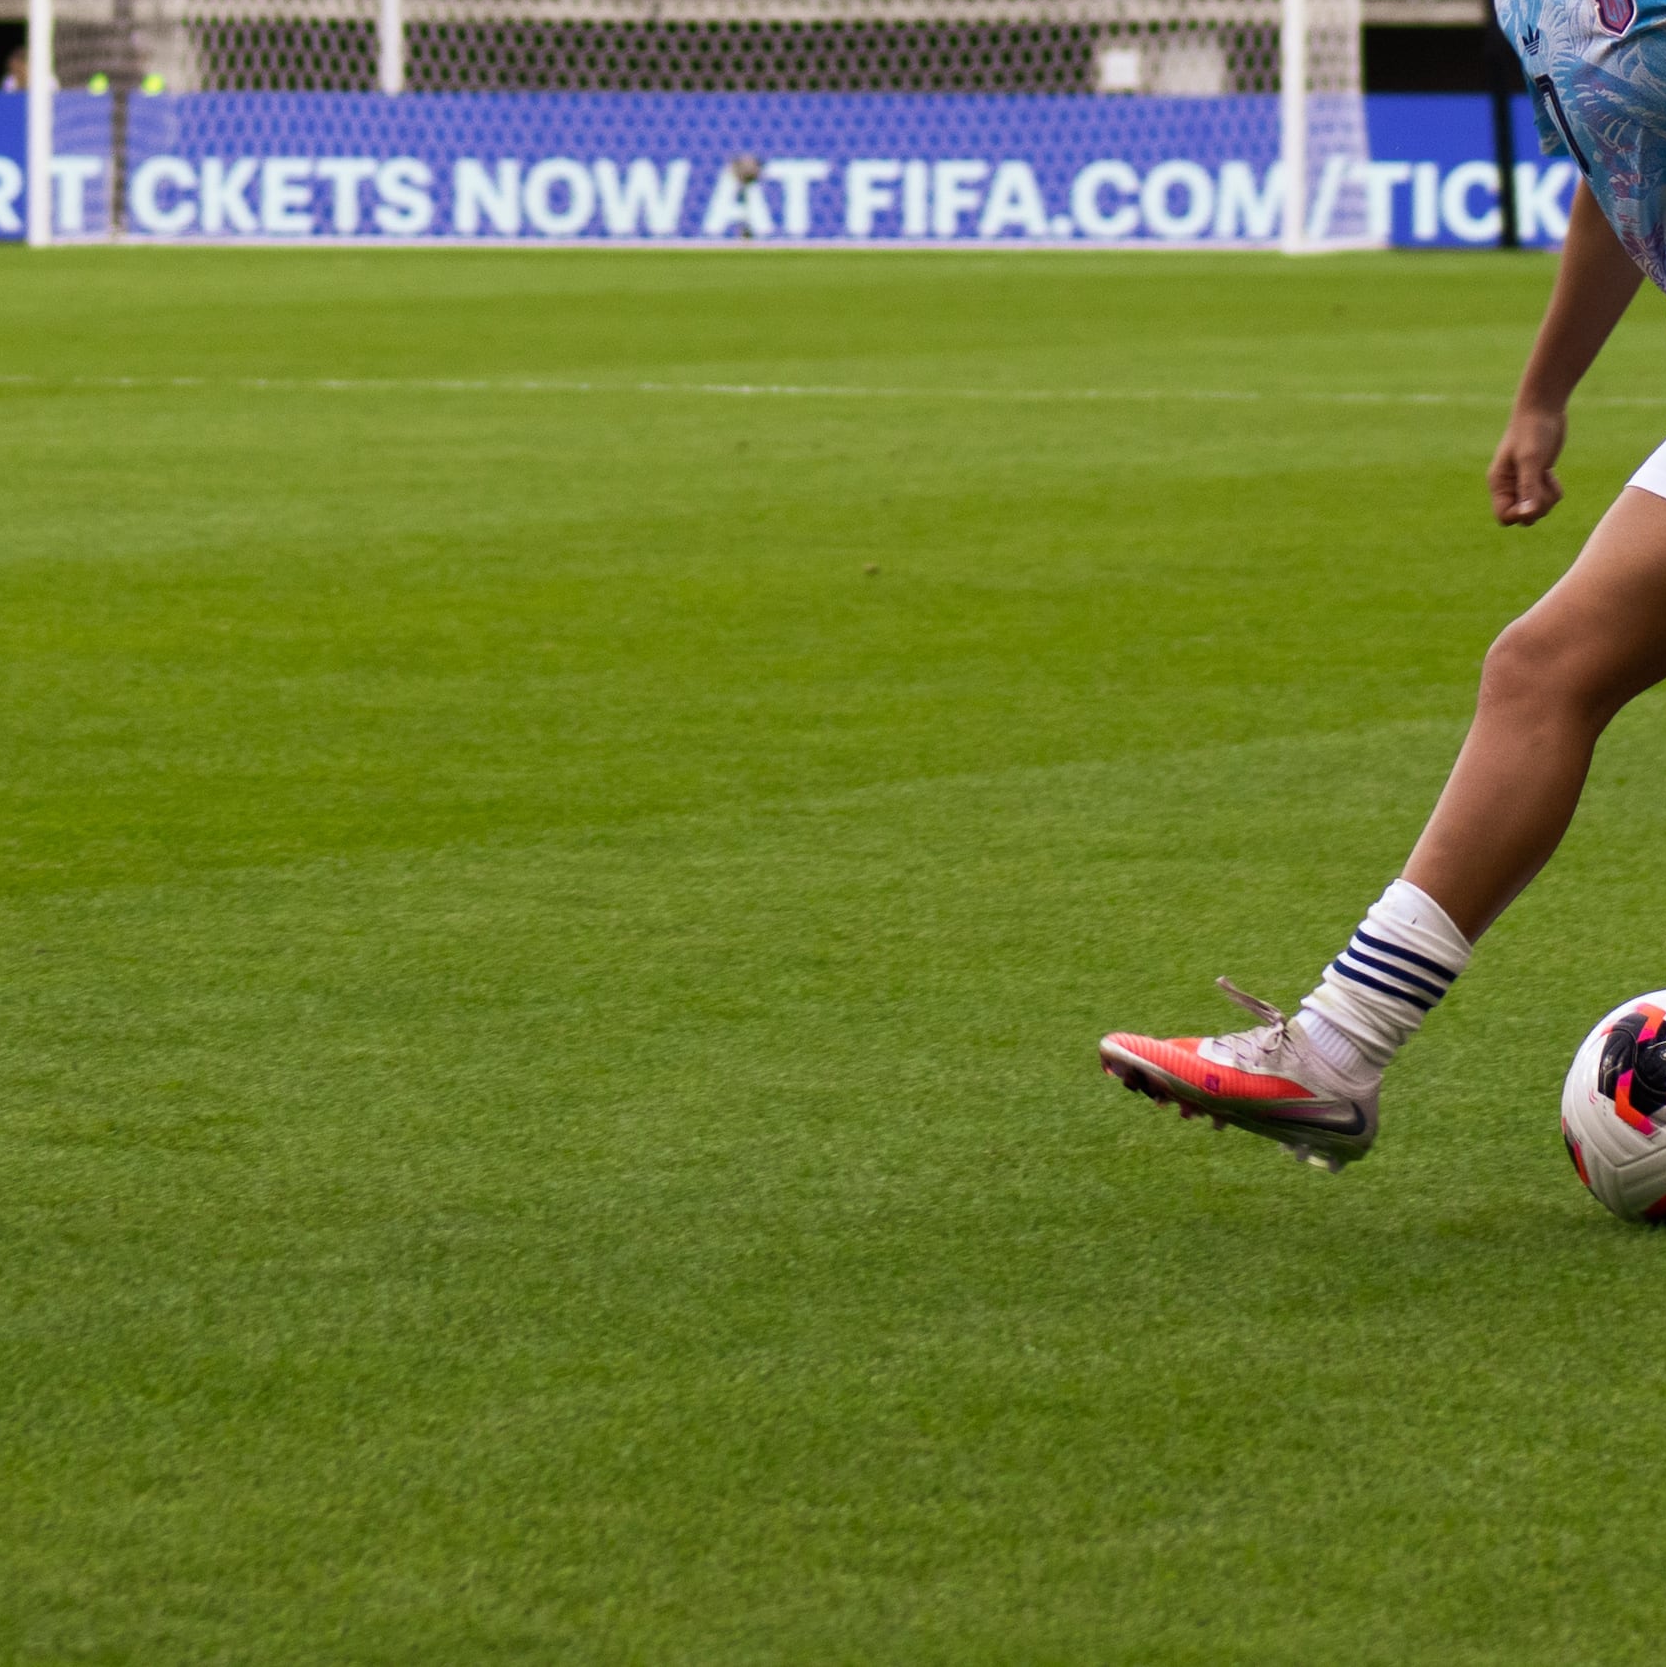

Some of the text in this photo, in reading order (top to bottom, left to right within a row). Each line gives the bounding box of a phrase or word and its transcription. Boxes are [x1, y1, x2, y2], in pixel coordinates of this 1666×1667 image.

[45, 154, 433, 235] TCKETS
[453, 157, 690, 238] NOW
[704, 157, 829, 238] AT
[846, 156, 1583, 243] FIFA.COM/TICK
